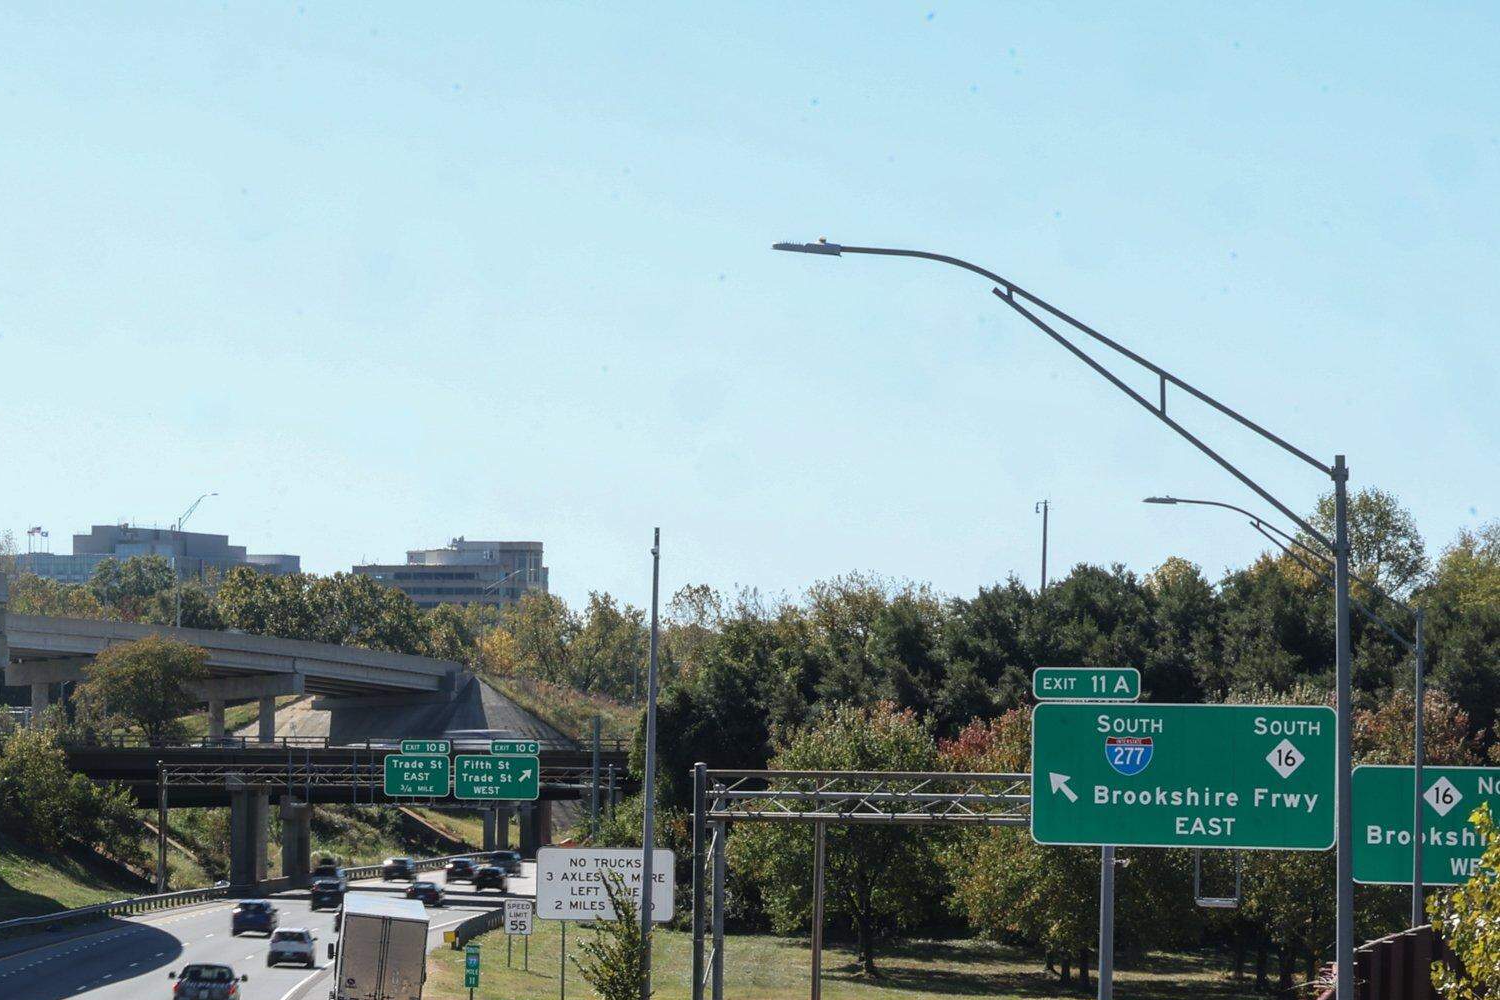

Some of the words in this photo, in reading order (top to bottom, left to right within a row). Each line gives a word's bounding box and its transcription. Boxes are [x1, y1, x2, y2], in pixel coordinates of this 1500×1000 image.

[1043, 677, 1077, 690] EXIT
[1097, 714, 1163, 733] SOUTH
[1253, 716, 1320, 736] SOUTH
[1114, 746, 1145, 765] 277
[1277, 749, 1296, 767] 16
[392, 759, 424, 769] Trade
[430, 760, 443, 769] St
[463, 760, 492, 769] Fifth
[498, 761, 510, 769] St
[404, 772, 430, 781] EAST
[462, 773, 493, 782] Trade
[500, 774, 512, 782] St
[473, 786, 500, 795] WEST
[1434, 787, 1454, 805] 16
[1093, 785, 1239, 807] Brookshire
[1254, 788, 1318, 813] Frwy
[1175, 816, 1236, 836] EAST
[569, 858, 586, 867] NO
[594, 858, 642, 868] TRUCKS
[546, 871, 554, 881] 3
[560, 872, 600, 882] AXLES
[631, 873, 665, 883] MRE
[571, 886, 600, 896] LEFT
[608, 887, 640, 897] ANE
[554, 900, 563, 910] 2
[569, 901, 606, 910] MILES
[510, 920, 527, 931] 55
